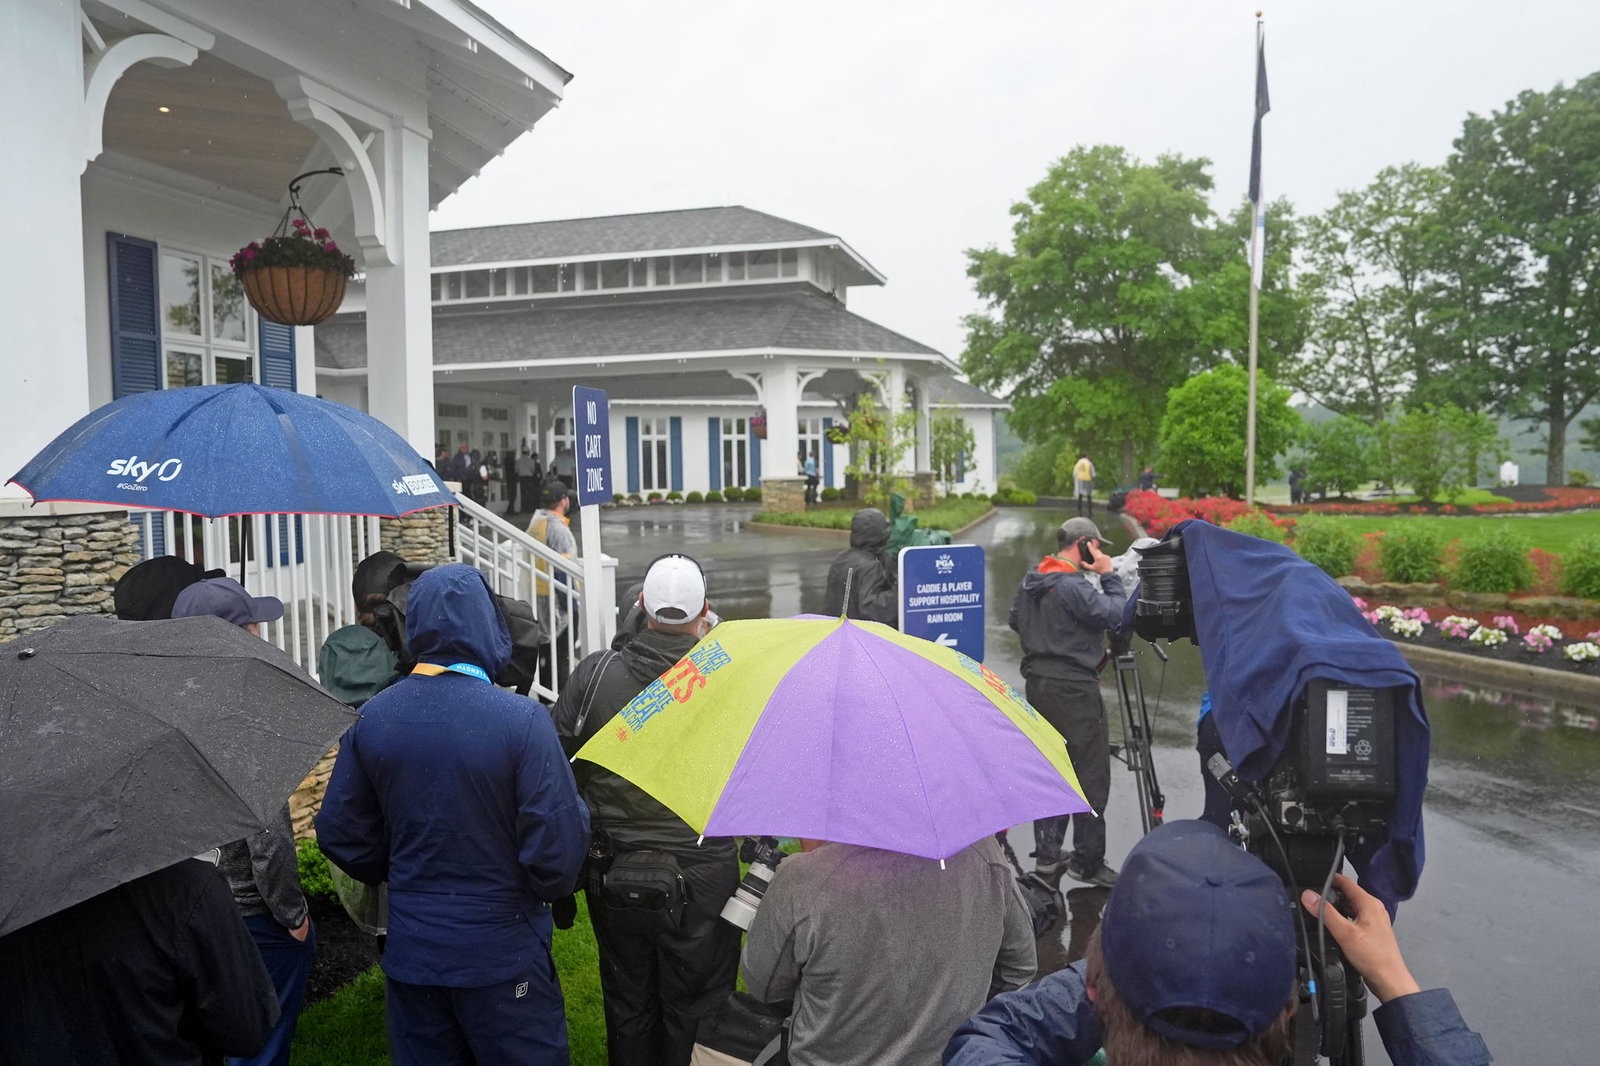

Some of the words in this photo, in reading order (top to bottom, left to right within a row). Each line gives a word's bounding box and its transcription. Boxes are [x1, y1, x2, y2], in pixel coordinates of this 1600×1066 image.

[586, 401, 597, 425] NO
[585, 434, 602, 459] CART
[106, 455, 160, 483] sky
[116, 482, 148, 492] #GoZero
[391, 479, 411, 496] sky
[407, 478, 435, 493] sports
[586, 468, 604, 492] ZONE
[935, 559, 955, 568] PGA
[916, 583, 941, 594] CADDIE
[941, 582, 948, 593] &
[948, 580, 973, 592] PLAYER
[909, 595, 939, 607] SUPPORT
[940, 593, 980, 605] HOSPITALITY
[927, 613, 943, 624] RAIN
[943, 612, 963, 623] ROOM
